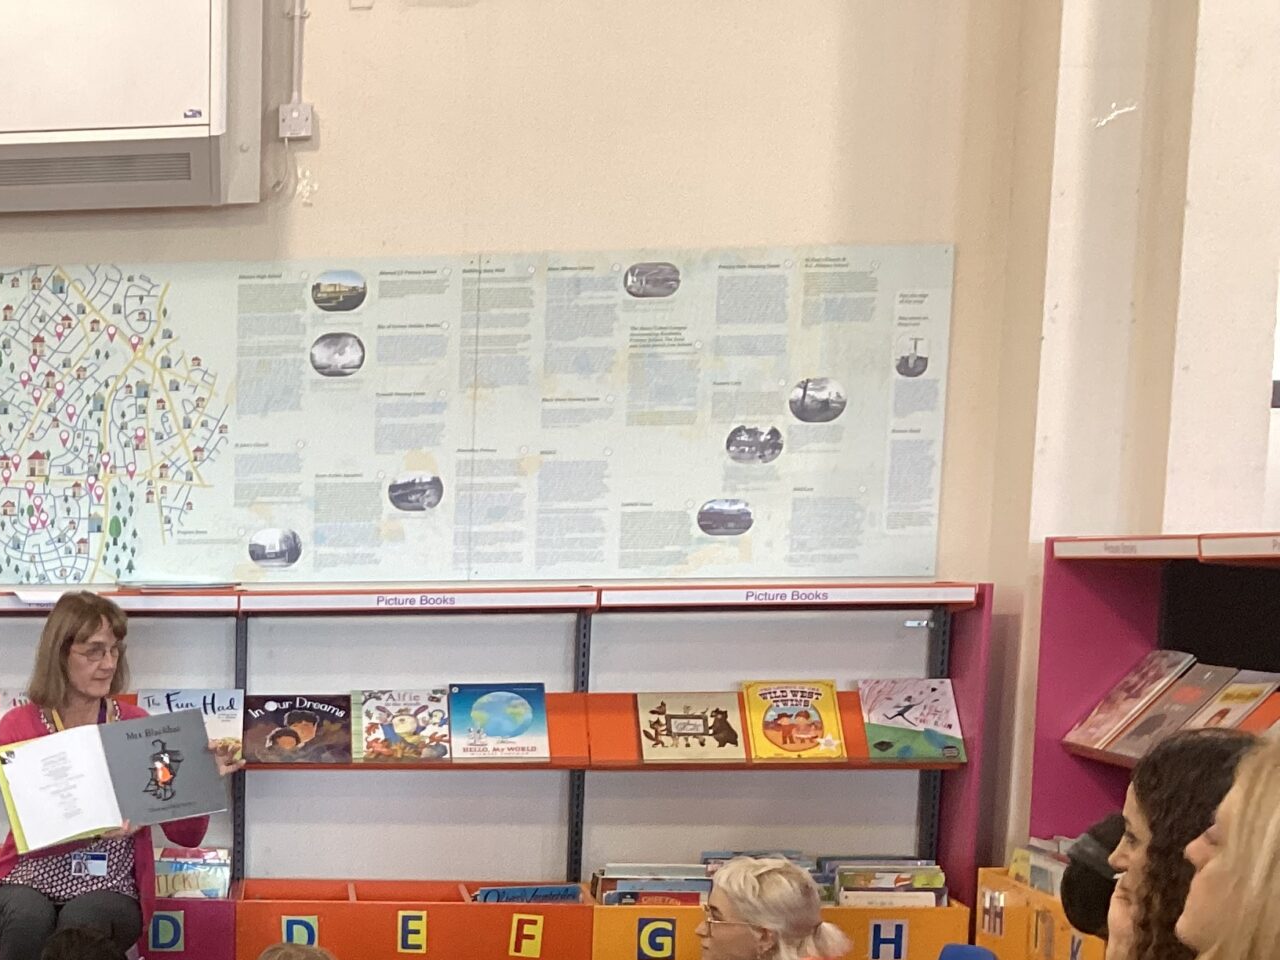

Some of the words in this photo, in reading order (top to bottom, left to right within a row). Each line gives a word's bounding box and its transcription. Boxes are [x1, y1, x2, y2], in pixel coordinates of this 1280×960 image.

[376, 595, 416, 606] Picture
[419, 595, 456, 606] Books
[745, 591, 788, 601] Picture
[791, 590, 829, 600] Books
[165, 691, 197, 713] Fun
[203, 692, 238, 715] Had
[758, 690, 788, 700] WILD
[790, 690, 822, 700] WEST
[772, 699, 810, 707] TWINS
[248, 708, 265, 719] In
[296, 697, 346, 718] Dreams
[155, 870, 200, 893] TICKY
[152, 914, 181, 949] D
[286, 920, 316, 945] D
[402, 915, 423, 950] E
[514, 918, 538, 953] F
[639, 920, 673, 958] G
[872, 923, 904, 960] H
